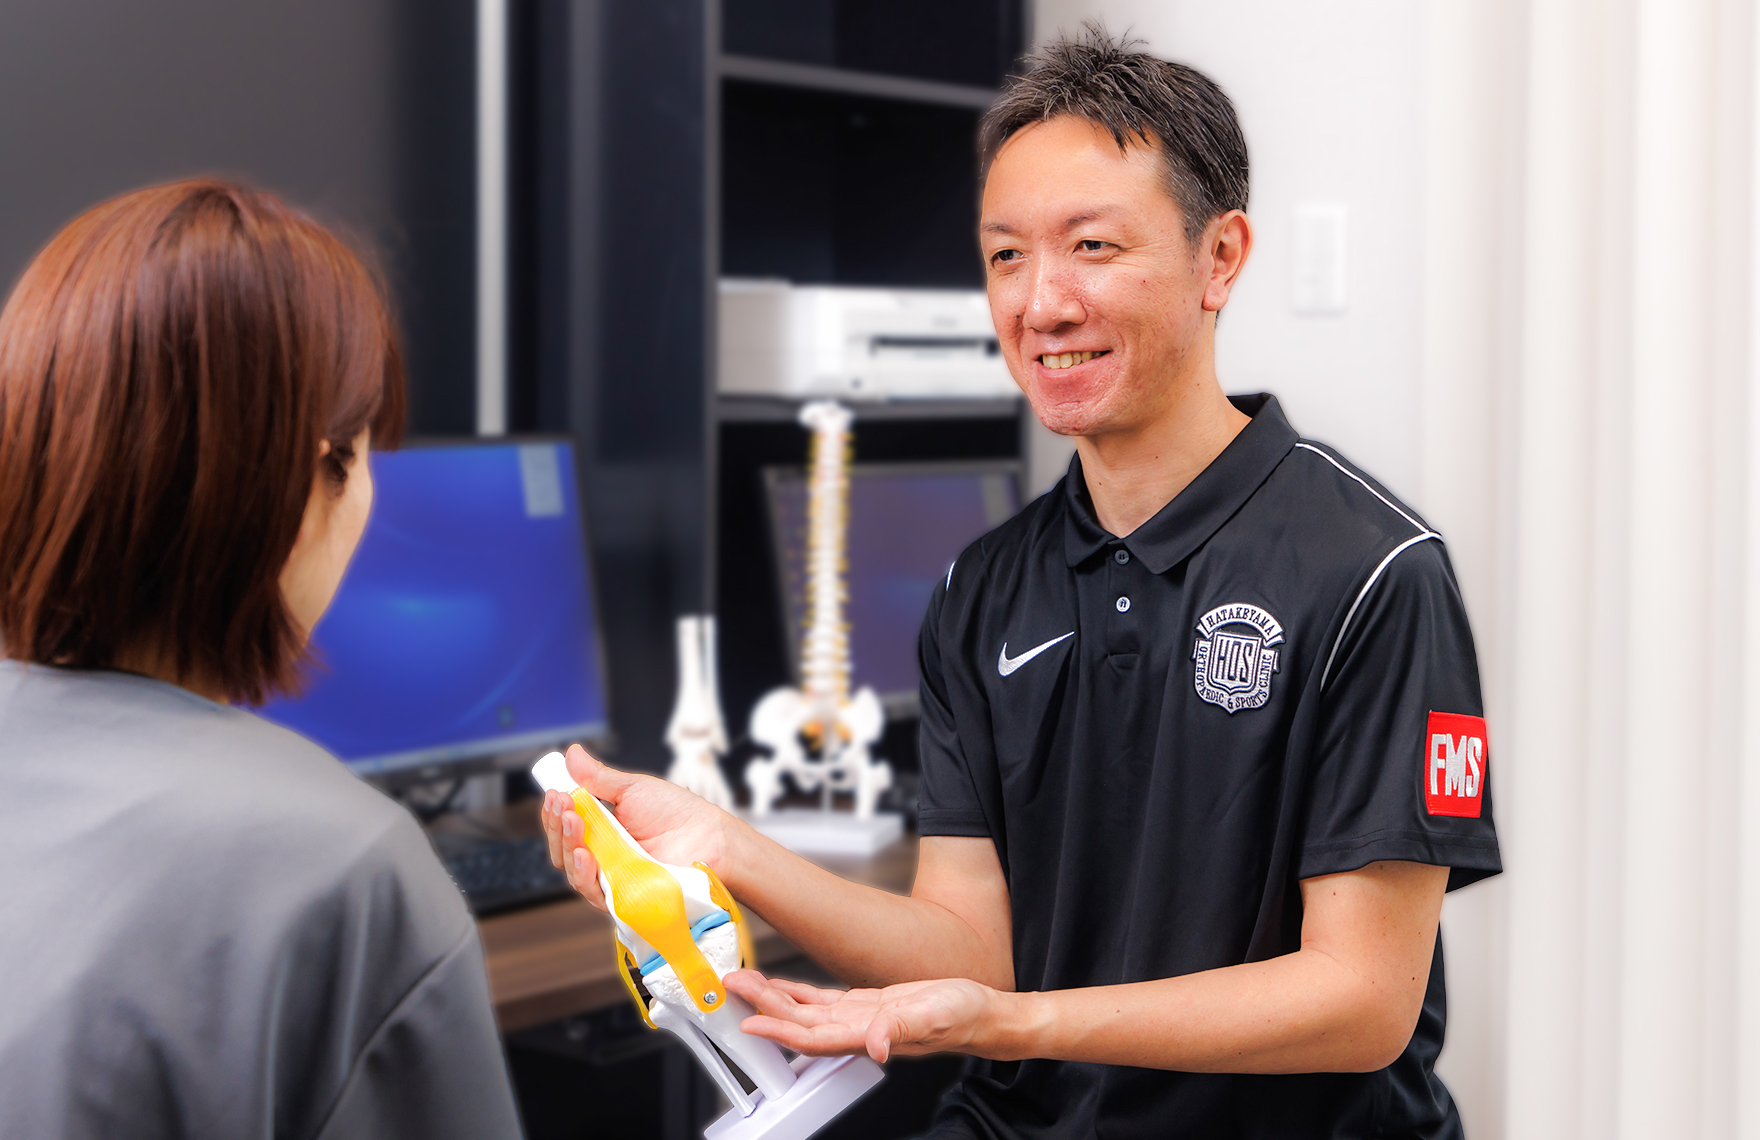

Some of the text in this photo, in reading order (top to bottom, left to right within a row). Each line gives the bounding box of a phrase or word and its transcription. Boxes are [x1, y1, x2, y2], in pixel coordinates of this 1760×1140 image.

[1206, 607, 1275, 635] HATAKEYAMA
[1196, 646, 1272, 709] ORTHOPAEDIC & SPORTS CLINIC
[1215, 639, 1254, 683] HOS
[1430, 733, 1482, 797] FMS
